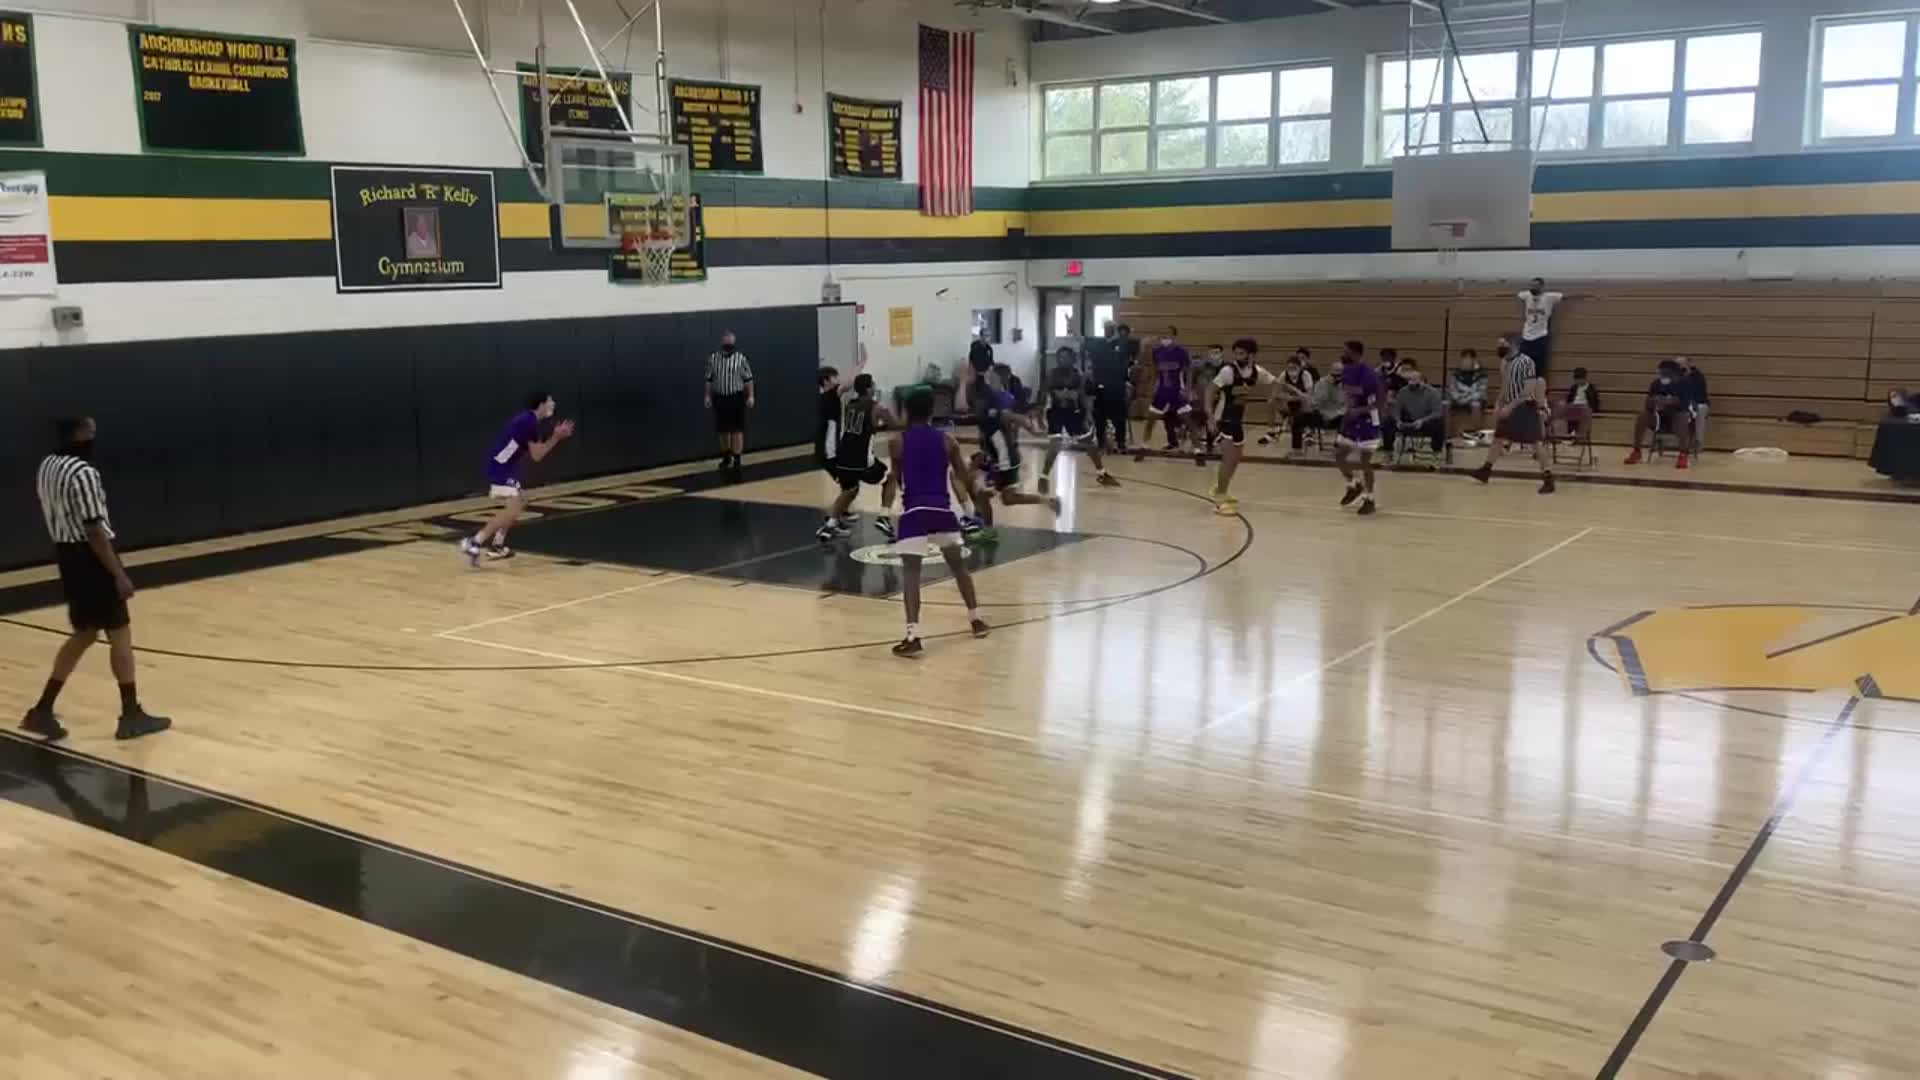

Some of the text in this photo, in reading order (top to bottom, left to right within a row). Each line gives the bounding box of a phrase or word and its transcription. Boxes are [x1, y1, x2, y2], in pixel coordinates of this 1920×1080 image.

[139, 33, 223, 57] ARCHBISHOP
[226, 41, 263, 60] WOOD
[143, 55, 289, 79] CATHOLIC LEAGUE CHAMPIONS
[188, 75, 251, 93] BASKETBALL
[359, 183, 417, 207] Richard
[442, 185, 479, 207] Kelly
[378, 255, 465, 281] Gymnasium
